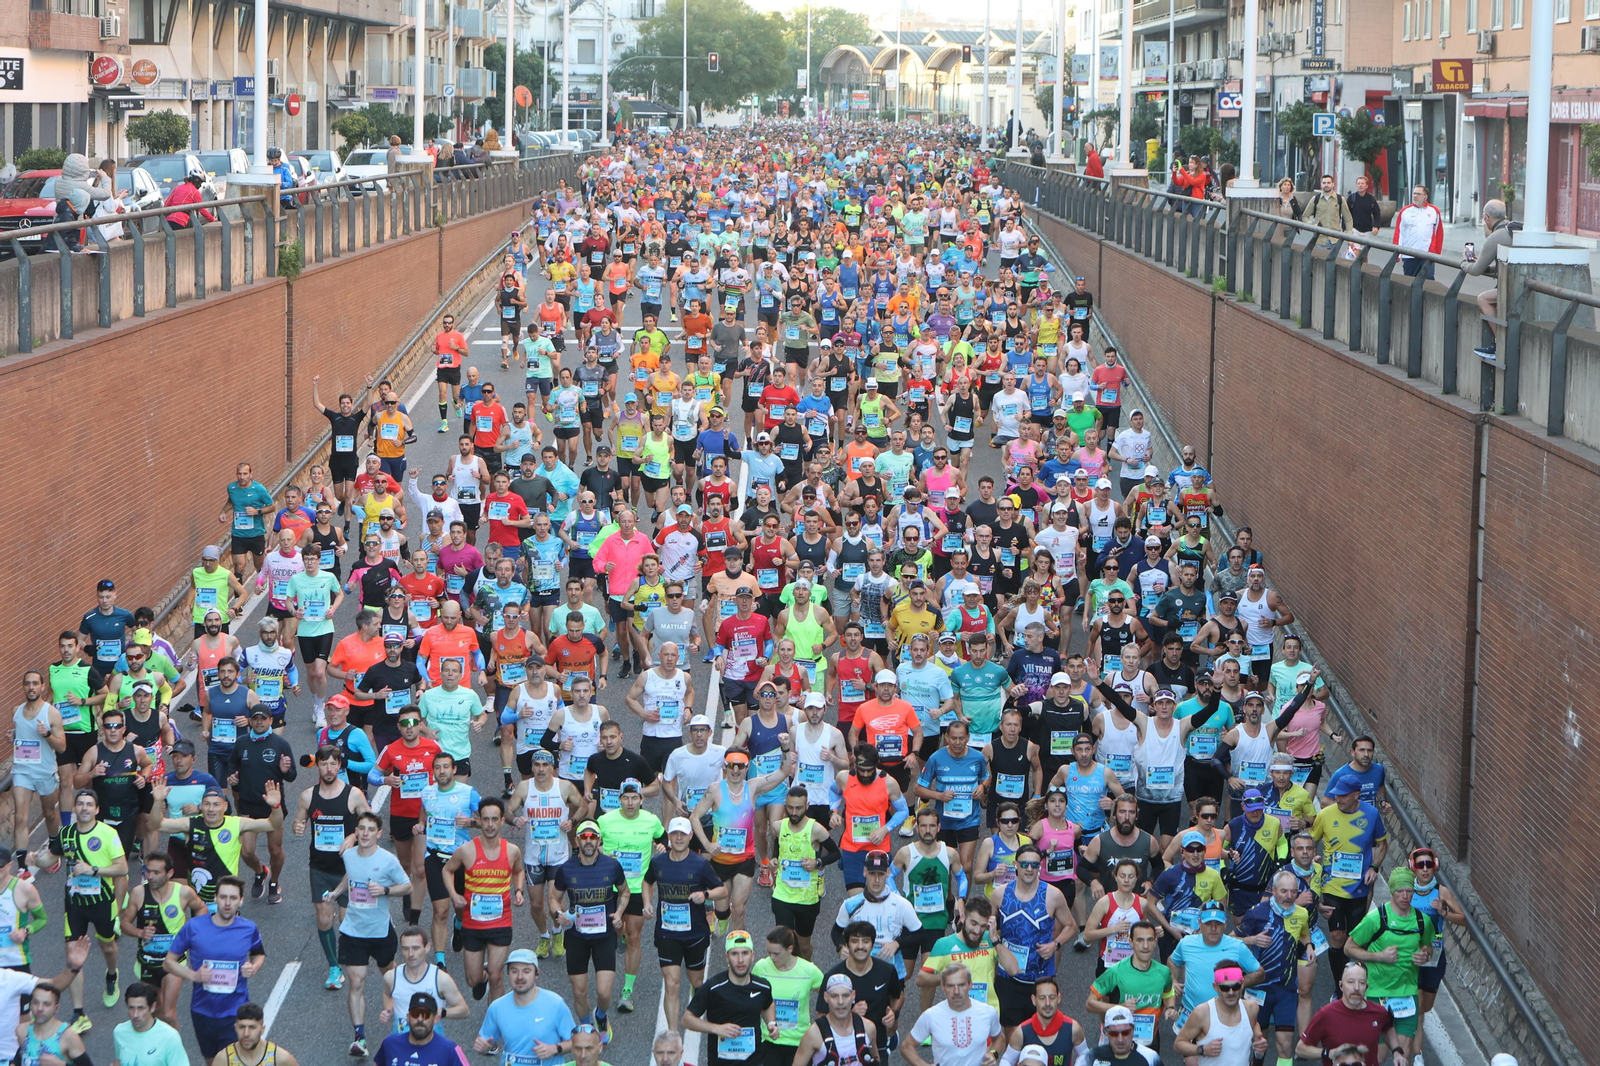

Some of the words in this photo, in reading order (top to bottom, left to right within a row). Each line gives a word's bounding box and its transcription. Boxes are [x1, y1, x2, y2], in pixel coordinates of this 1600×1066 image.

[94, 65, 117, 80] Cruzcampo
[1570, 102, 1588, 119] KEBAB
[1035, 665, 1052, 673] TRAIL
[527, 807, 562, 818] MADRID
[472, 868, 509, 877] SERPENTINE
[1008, 946, 1024, 954] ZURICH
